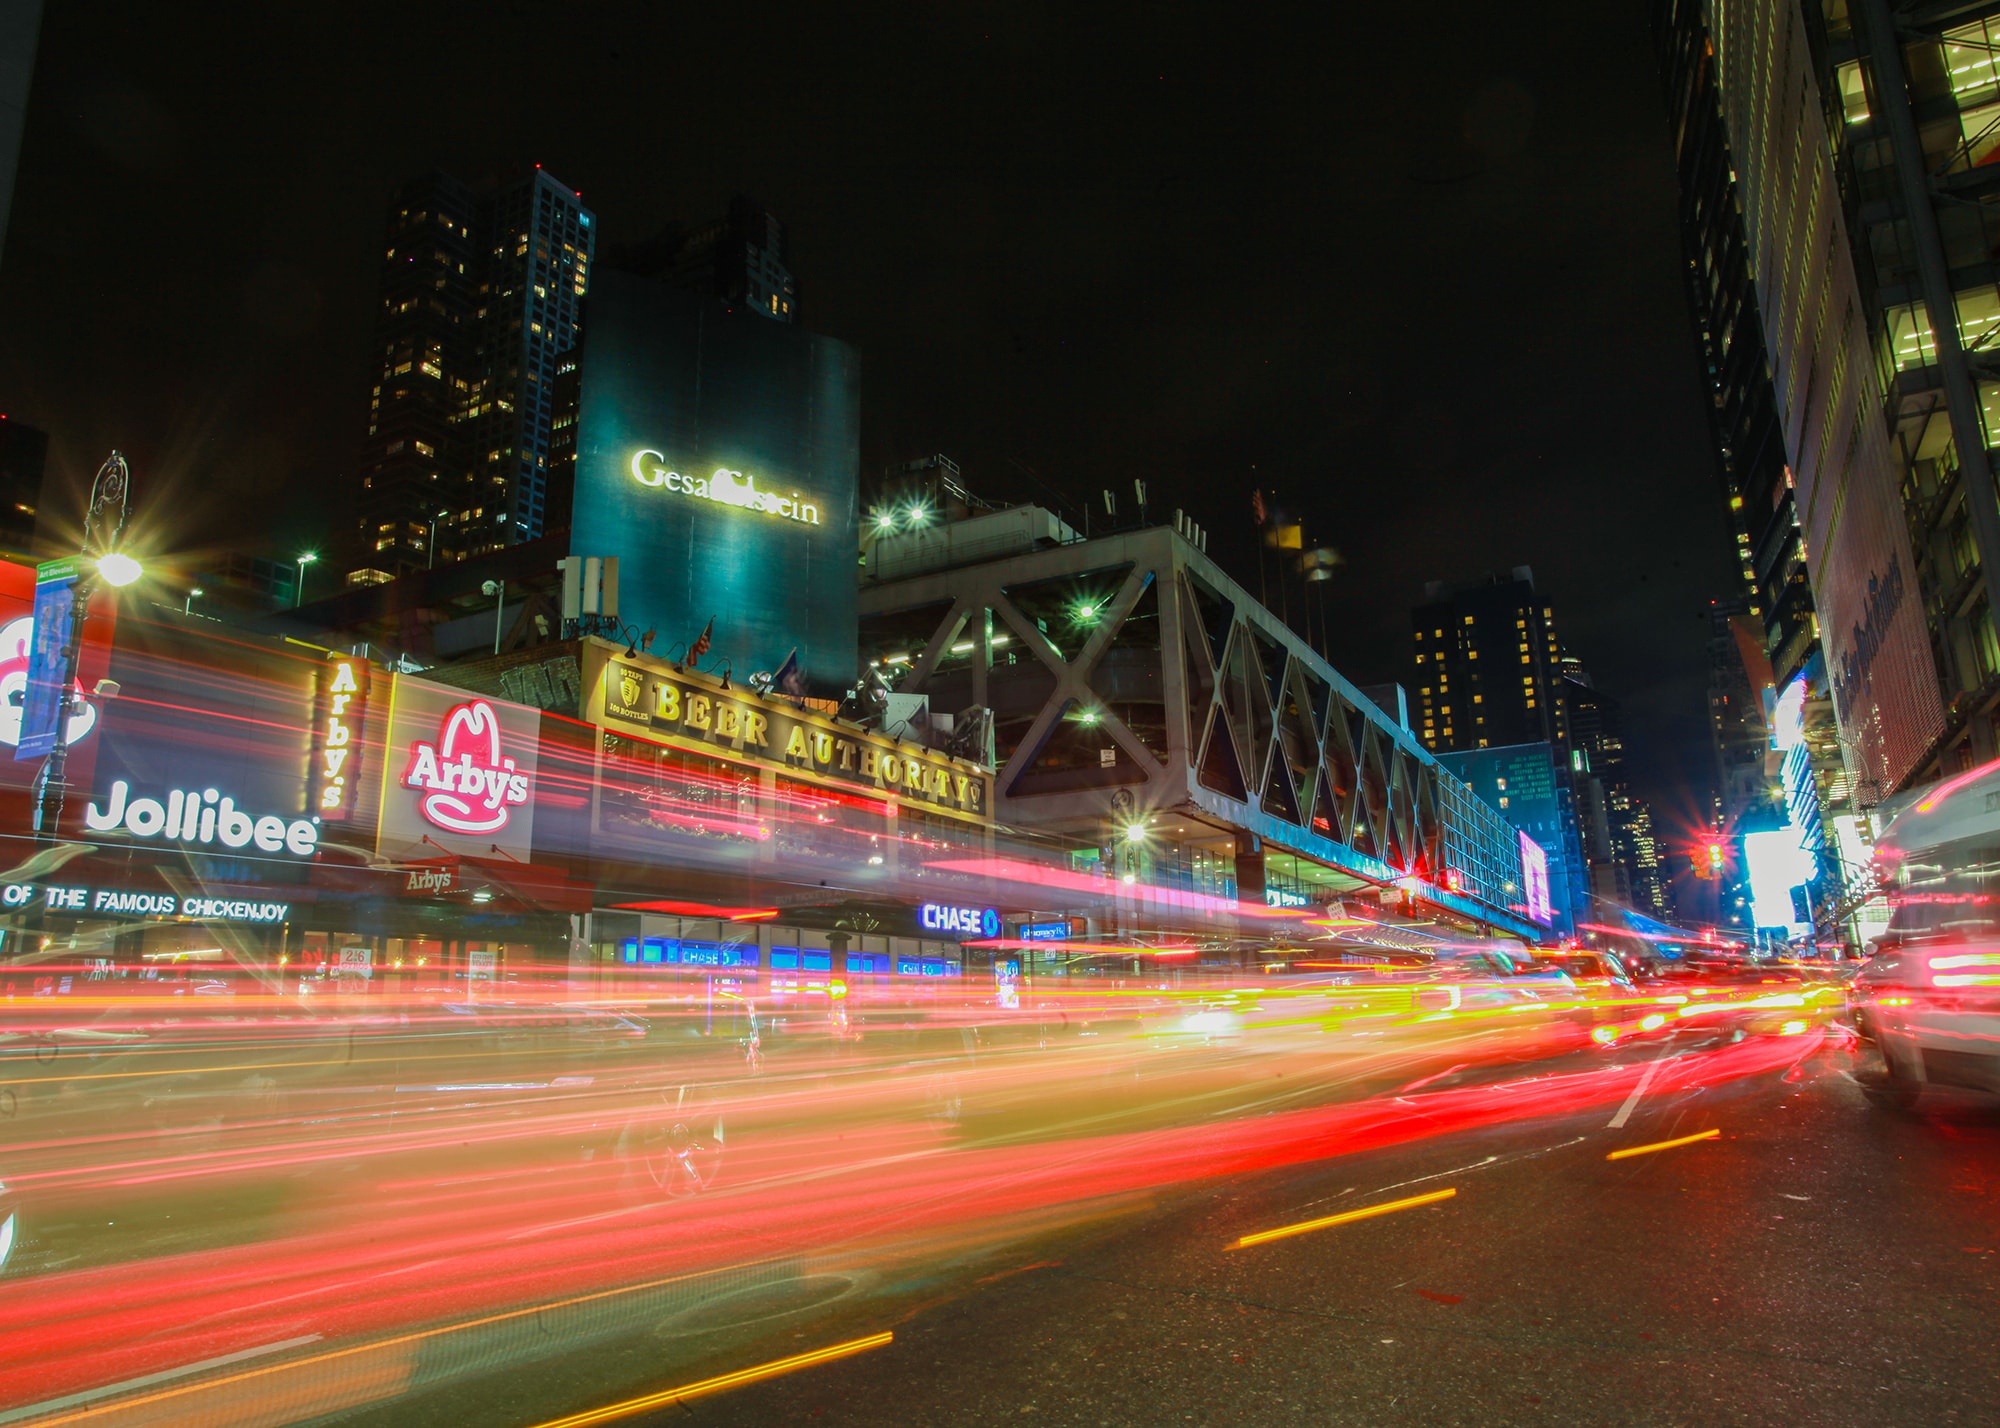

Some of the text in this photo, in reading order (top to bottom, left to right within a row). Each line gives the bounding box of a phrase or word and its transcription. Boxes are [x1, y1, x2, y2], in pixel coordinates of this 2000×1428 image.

[628, 671, 643, 682] TAPS
[609, 703, 649, 721] 100 BOTTLES
[321, 663, 357, 808] Arby's
[653, 682, 969, 802] BEER AUTHORITY
[408, 745, 528, 810] Arby's
[86, 780, 318, 855] Jollibee
[406, 866, 451, 891] Arby's
[4, 885, 288, 921] OF THE FAMOUS CHICKENJOY
[924, 904, 981, 933] CHASE
[681, 952, 719, 964] CHASE
